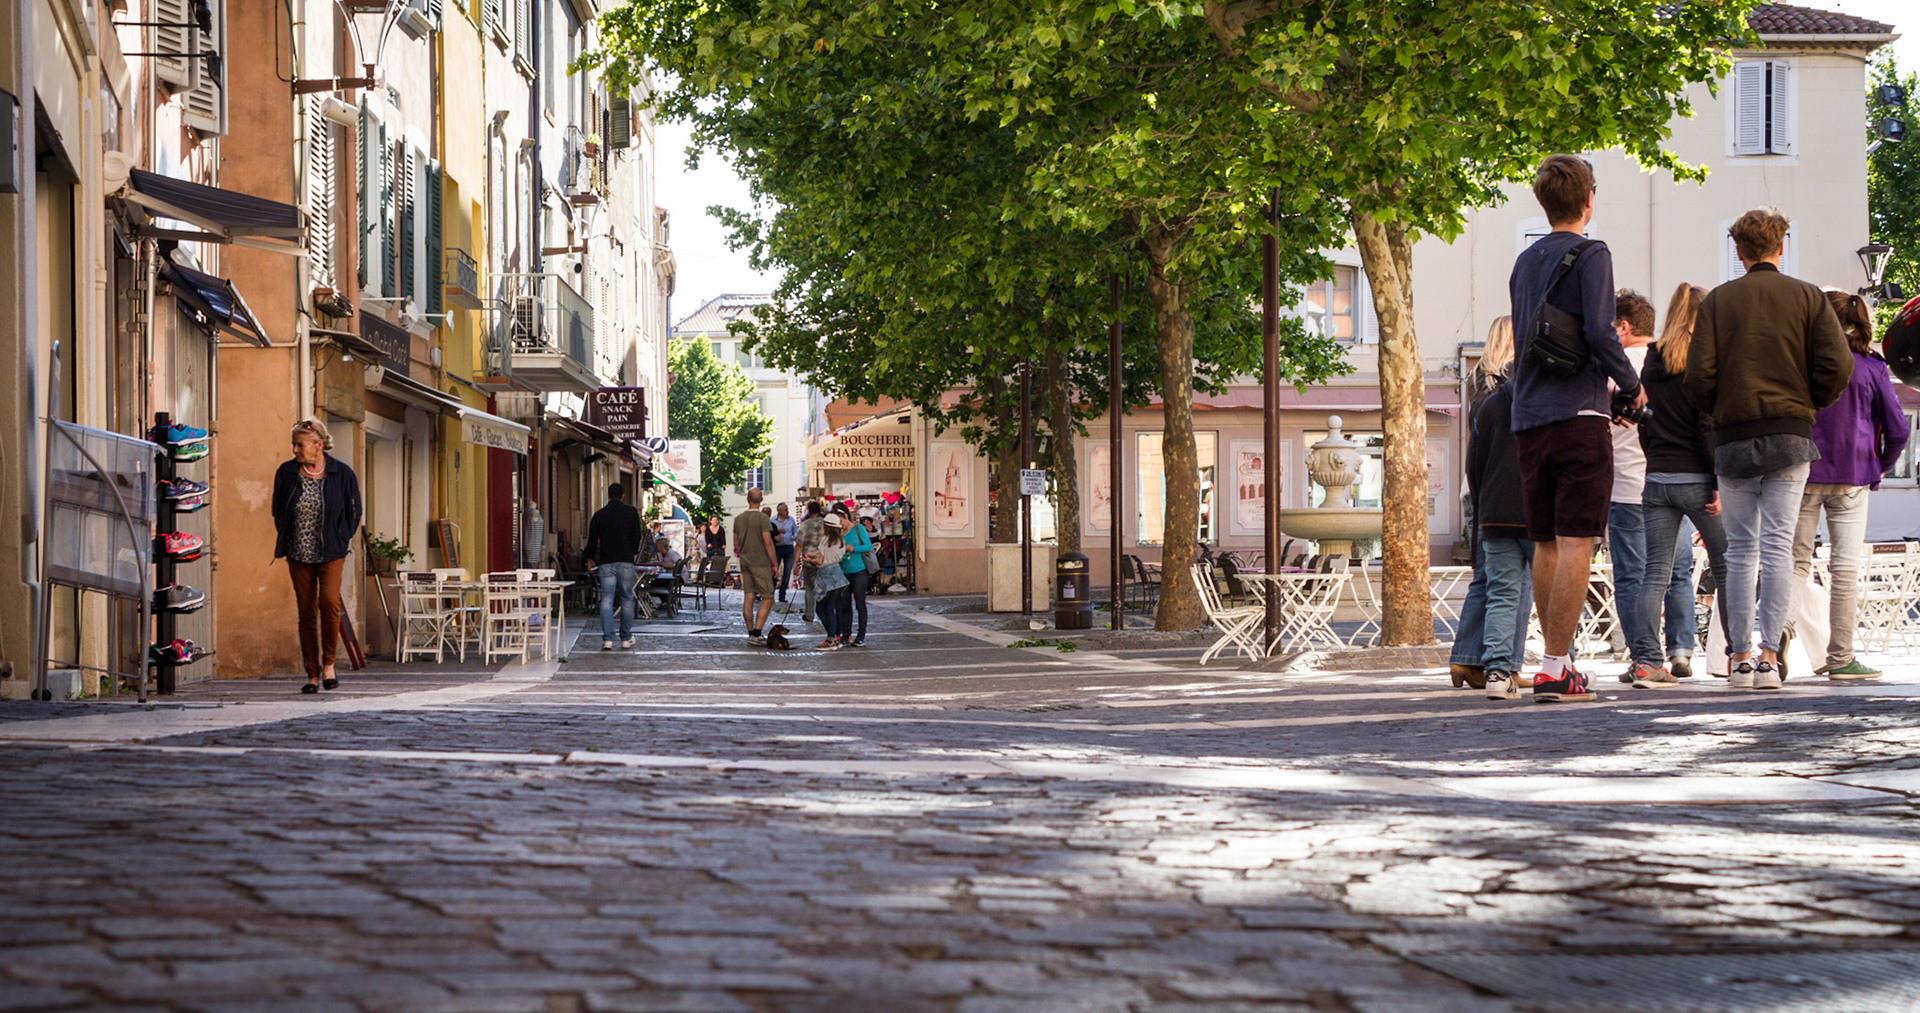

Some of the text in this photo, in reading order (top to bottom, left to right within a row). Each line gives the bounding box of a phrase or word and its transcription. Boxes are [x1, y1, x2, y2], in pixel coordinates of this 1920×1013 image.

[393, 339, 408, 366] Café
[596, 389, 638, 404] CAFÉ
[601, 405, 633, 413] SNACK
[607, 414, 628, 422] PAIN
[823, 447, 915, 458] CHARCUTERIE
[816, 460, 915, 468] ROTISSERIE TRAITEUR
